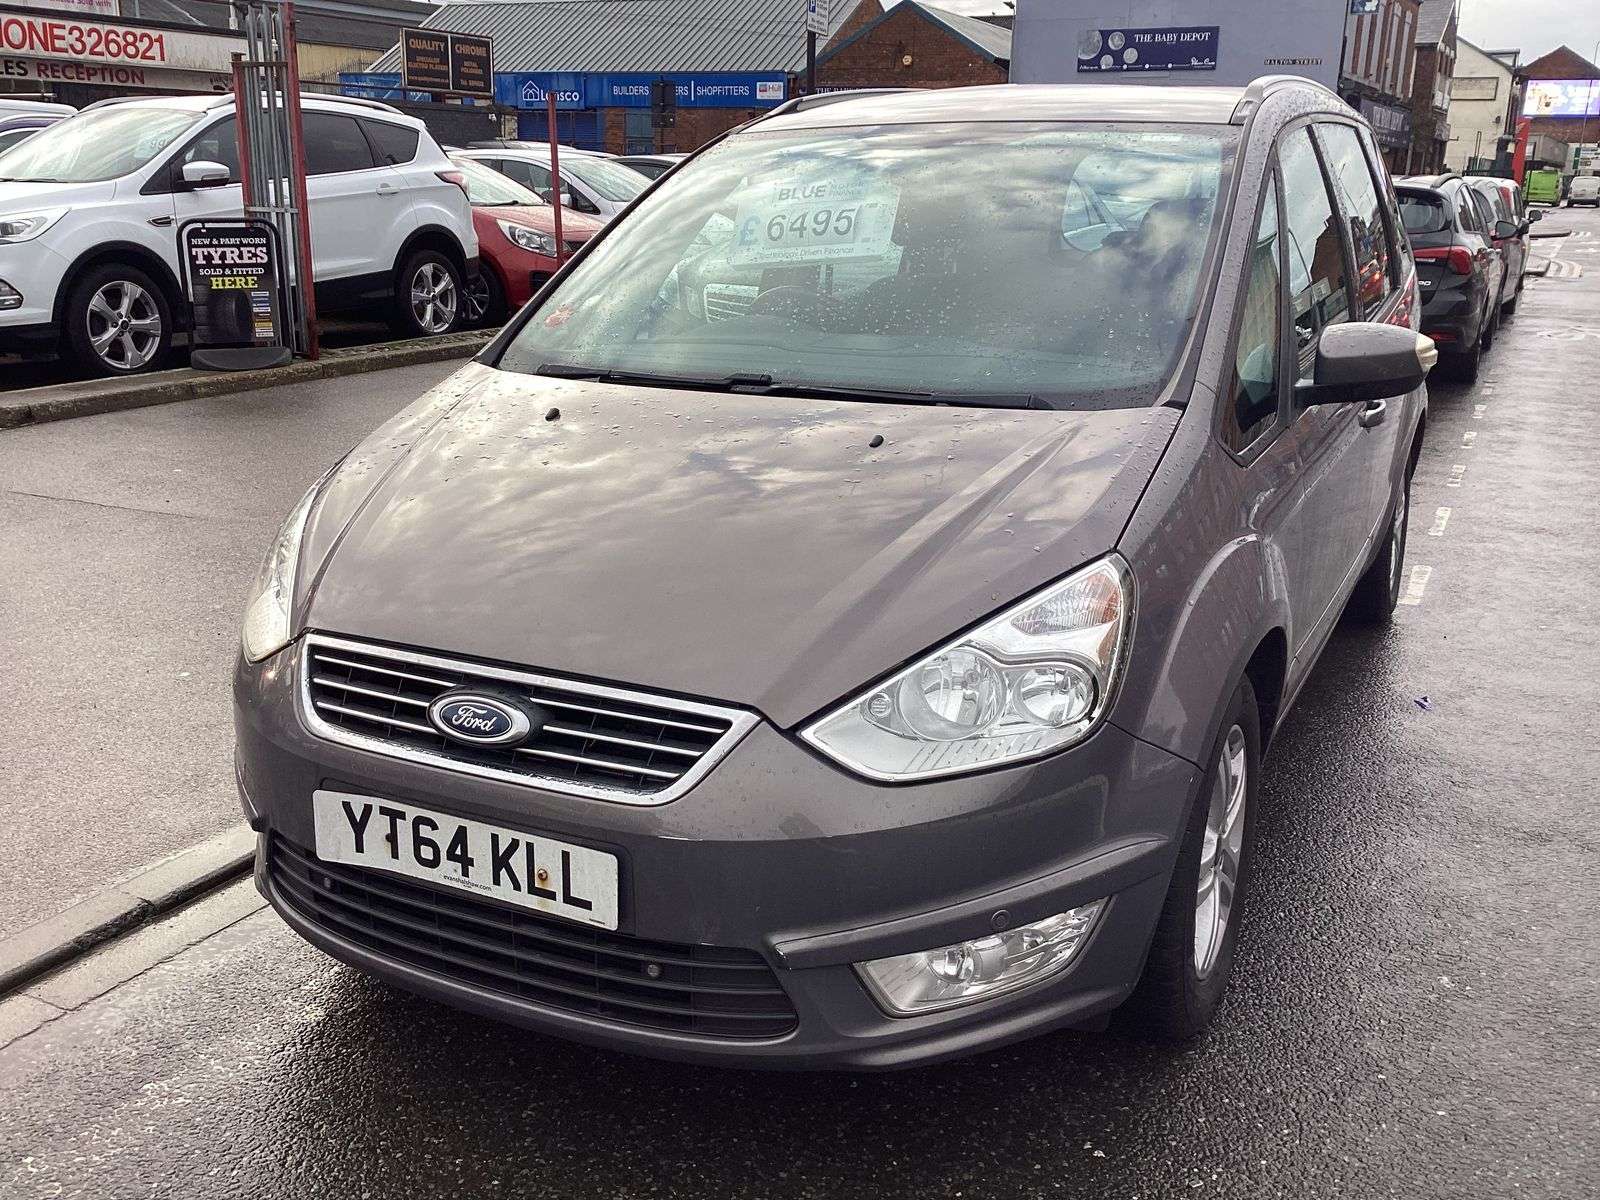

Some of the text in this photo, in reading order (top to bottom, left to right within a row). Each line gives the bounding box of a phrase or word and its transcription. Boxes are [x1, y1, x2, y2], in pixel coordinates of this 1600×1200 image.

[0, 18, 166, 61] ONE326821
[1134, 32, 1211, 43] THE BABY DEPOT
[409, 39, 445, 51] QUALITY
[454, 44, 487, 56] CHROME
[36, 61, 145, 84] RECEPTION
[613, 84, 649, 96] BUILDERS
[696, 84, 750, 97] SHOPFITTERS
[778, 184, 827, 201] BLUE
[191, 247, 268, 264] TYRES
[232, 267, 265, 275] FITTED
[210, 276, 258, 289] HERE
[452, 705, 497, 732] Ford
[341, 800, 593, 912] YT64 KLL
